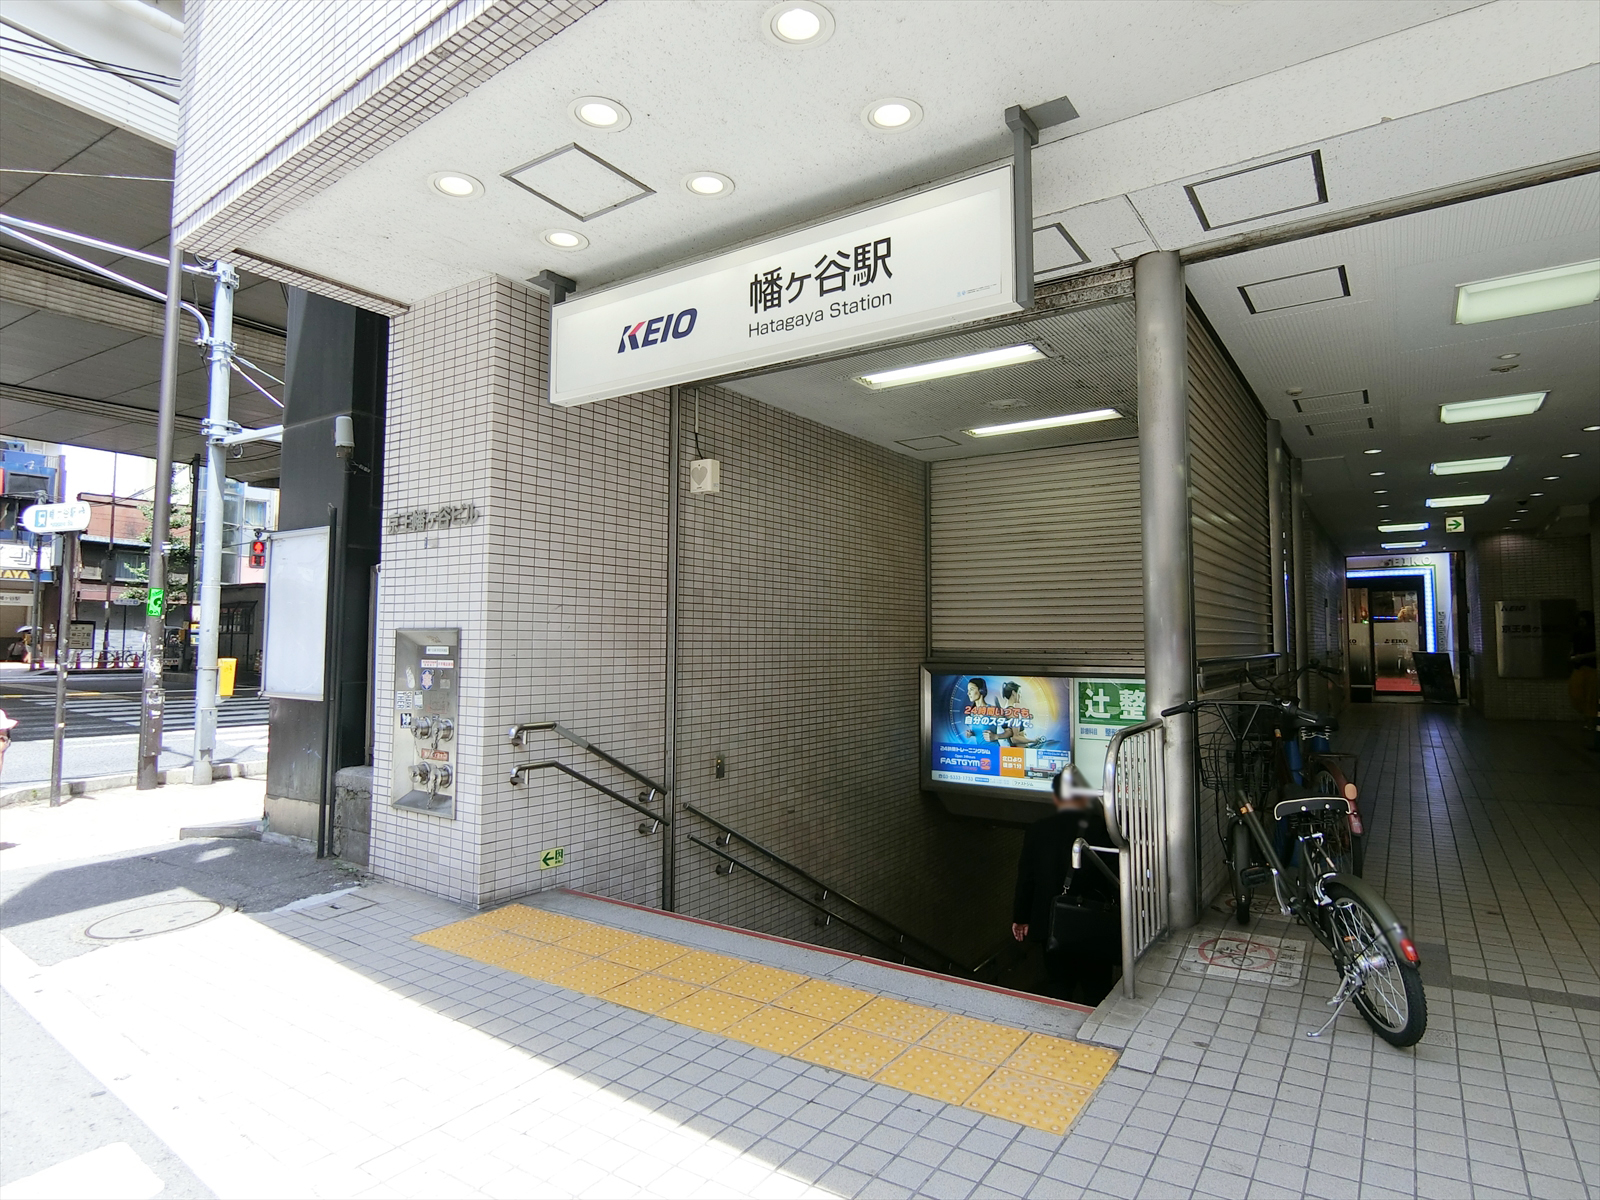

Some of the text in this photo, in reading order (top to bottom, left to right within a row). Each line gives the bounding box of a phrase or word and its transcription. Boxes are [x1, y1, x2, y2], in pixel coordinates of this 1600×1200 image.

[749, 236, 893, 314] 幡ヶ谷駅
[617, 307, 699, 354] KEIO
[748, 290, 893, 338] Hatagaya Station
[388, 503, 480, 535] 京王幡ヶ谷ビル
[964, 706, 1033, 719] 24時間いつでも、
[964, 717, 1033, 729] 自分のスタイルで。
